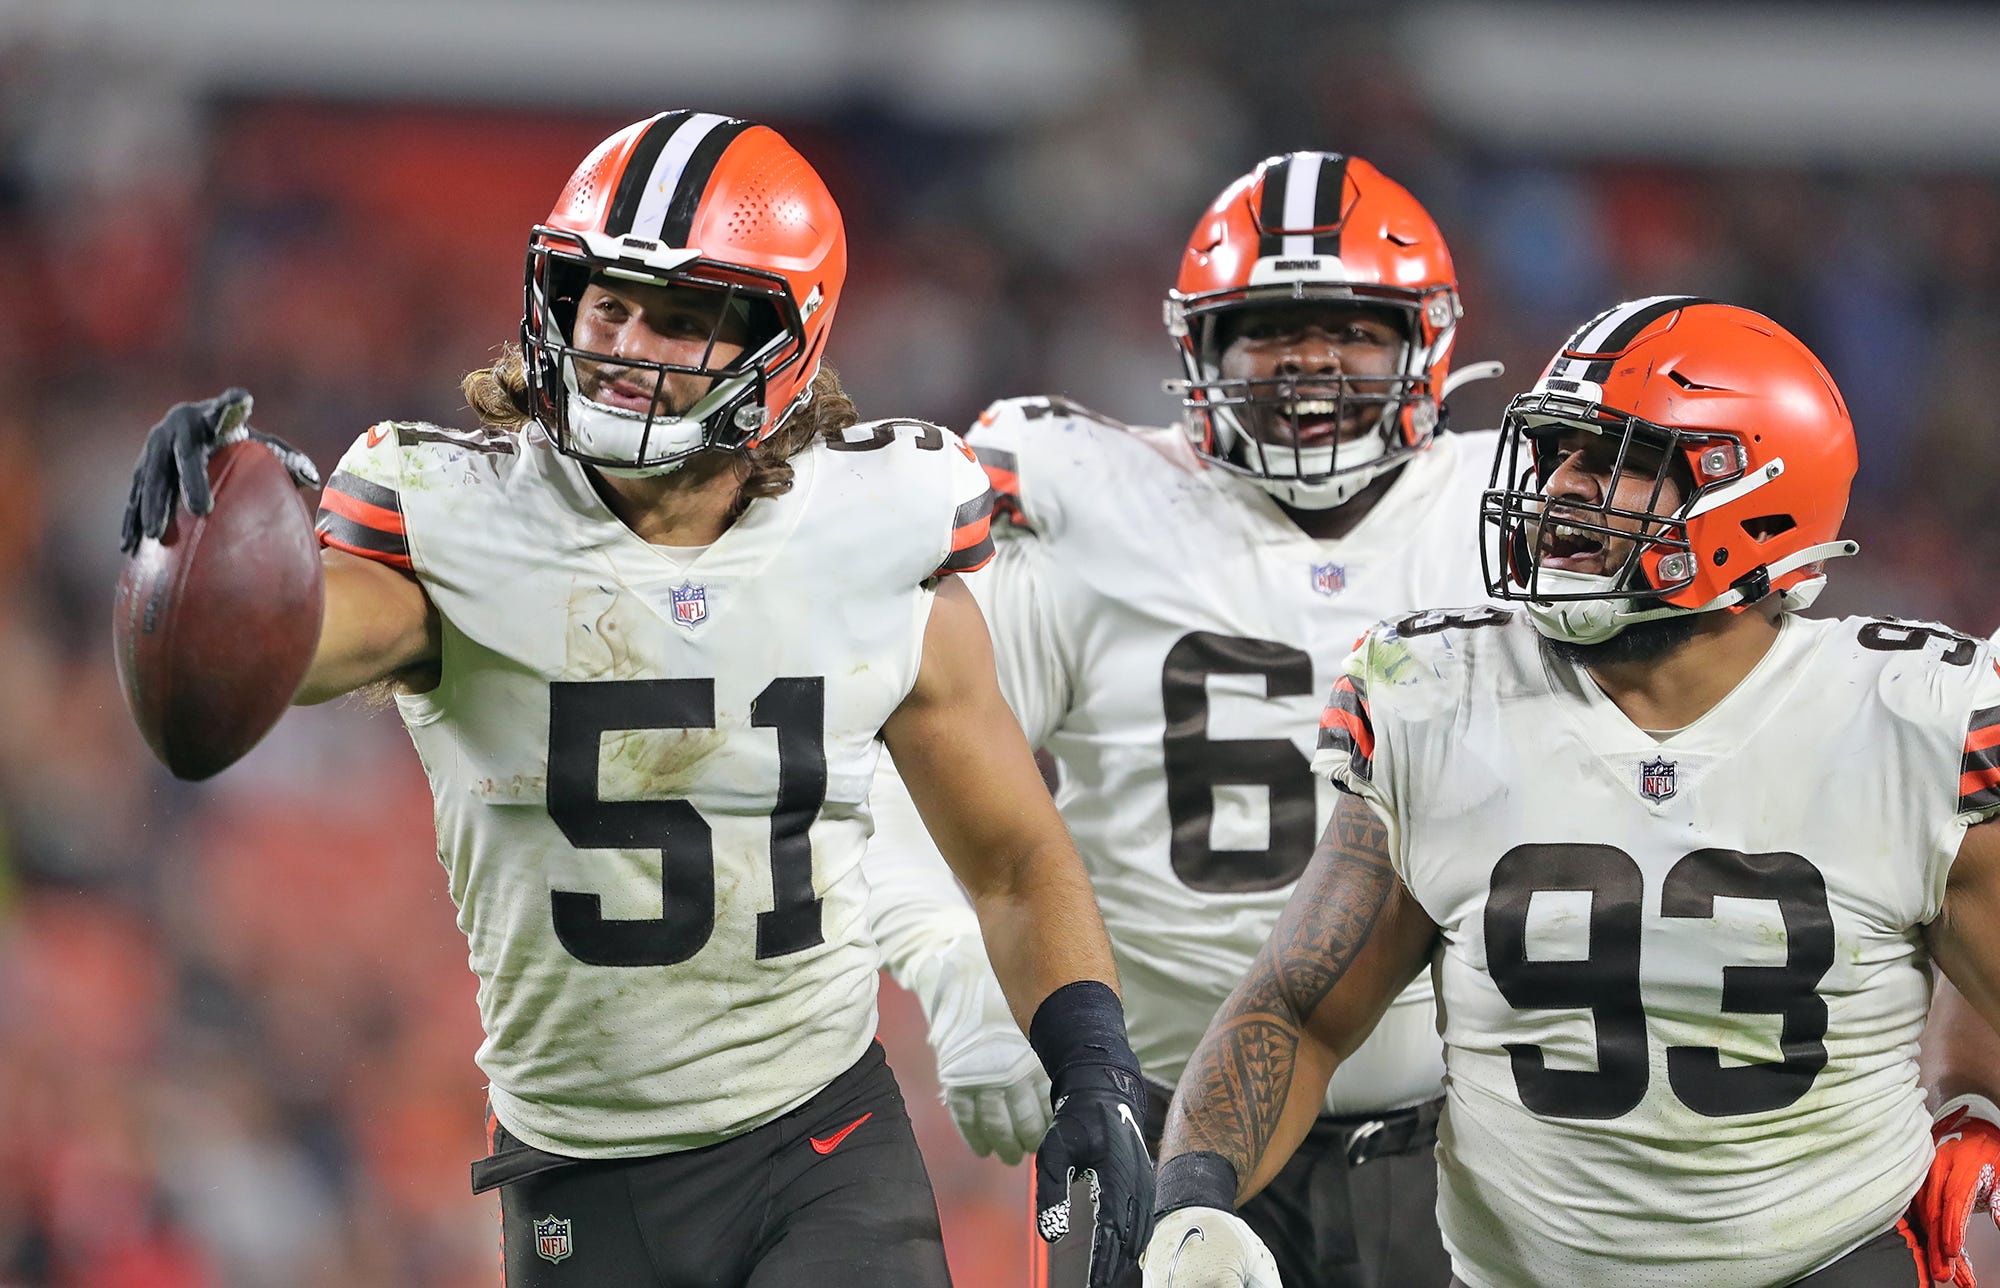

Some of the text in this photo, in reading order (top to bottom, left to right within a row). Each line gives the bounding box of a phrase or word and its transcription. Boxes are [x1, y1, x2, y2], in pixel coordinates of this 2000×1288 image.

[1274, 260, 1321, 271] BROWNS
[677, 601, 704, 620] NFL
[1645, 777, 1671, 795] NFL
[546, 676, 828, 967] 51
[1483, 842, 1835, 1120] 93
[541, 1237, 567, 1256] NFL
